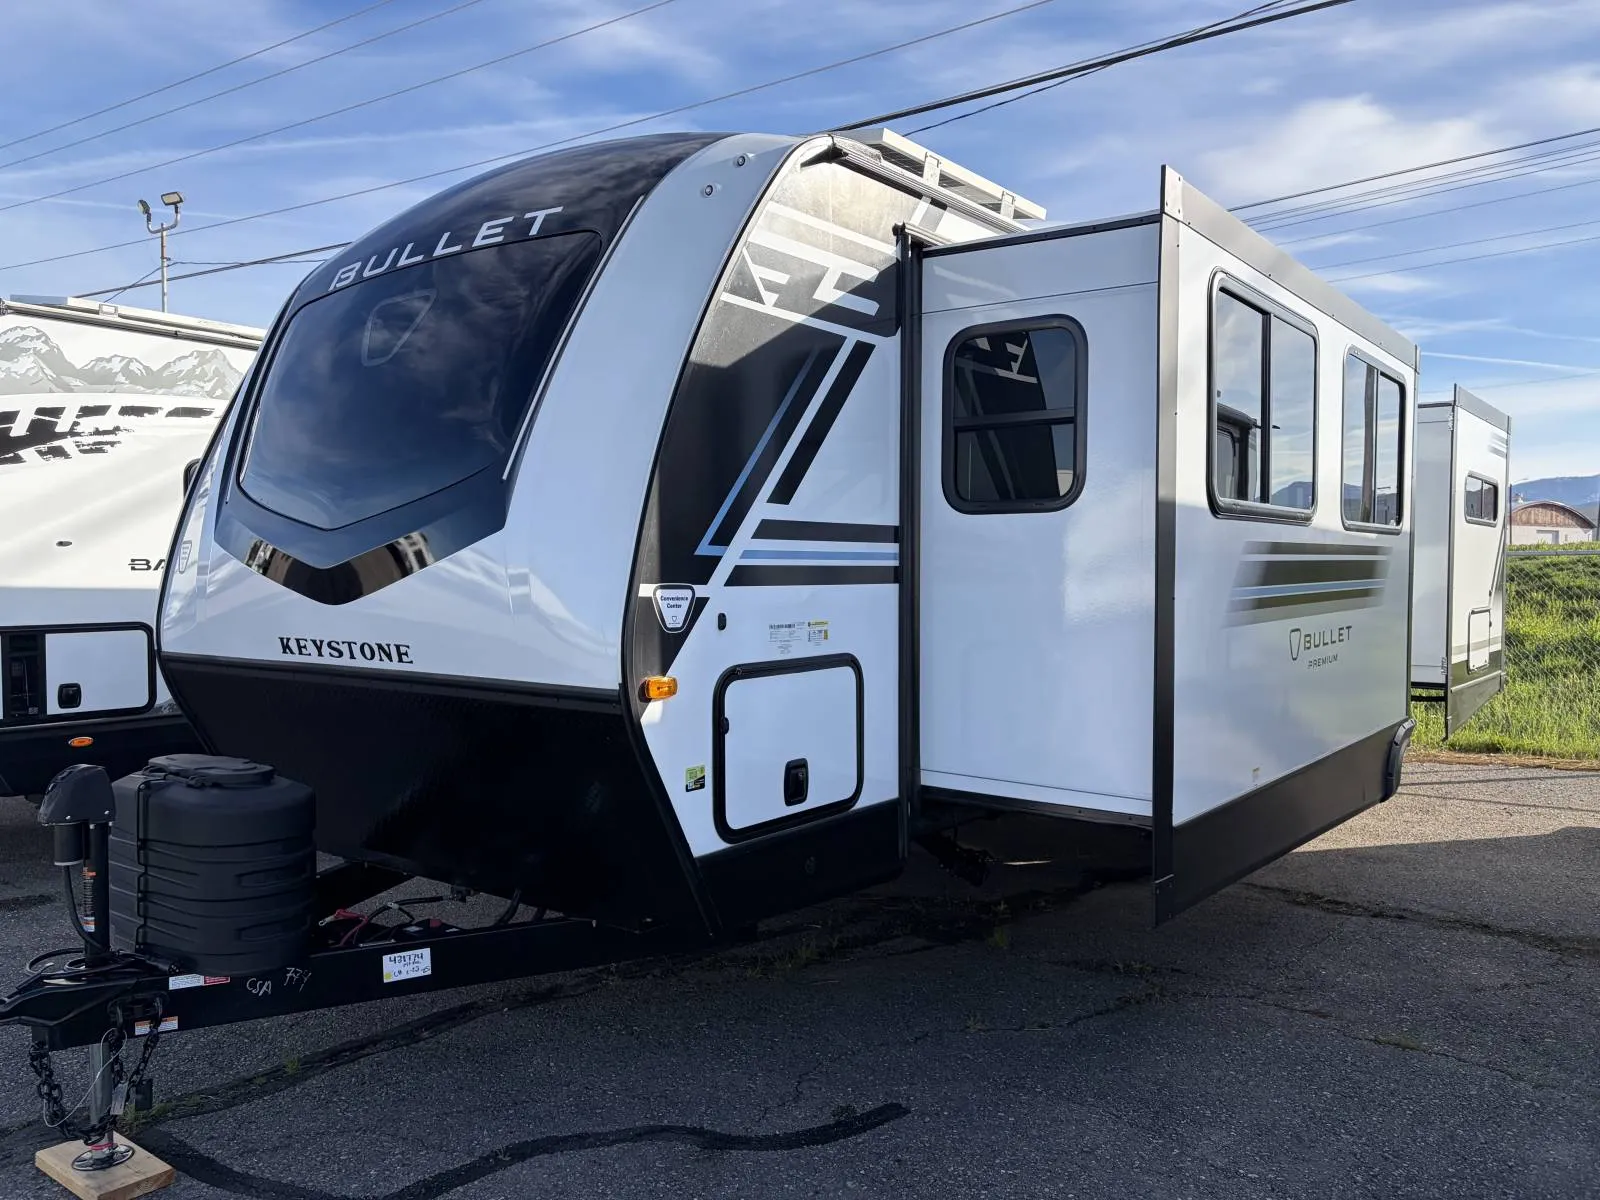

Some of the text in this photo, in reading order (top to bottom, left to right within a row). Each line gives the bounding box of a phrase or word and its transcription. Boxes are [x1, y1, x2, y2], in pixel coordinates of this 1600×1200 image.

[328, 206, 564, 292] BULLET
[278, 636, 414, 664] KEYSTONE
[1303, 625, 1352, 651] BULLET
[1308, 653, 1338, 669] PREMIUM
